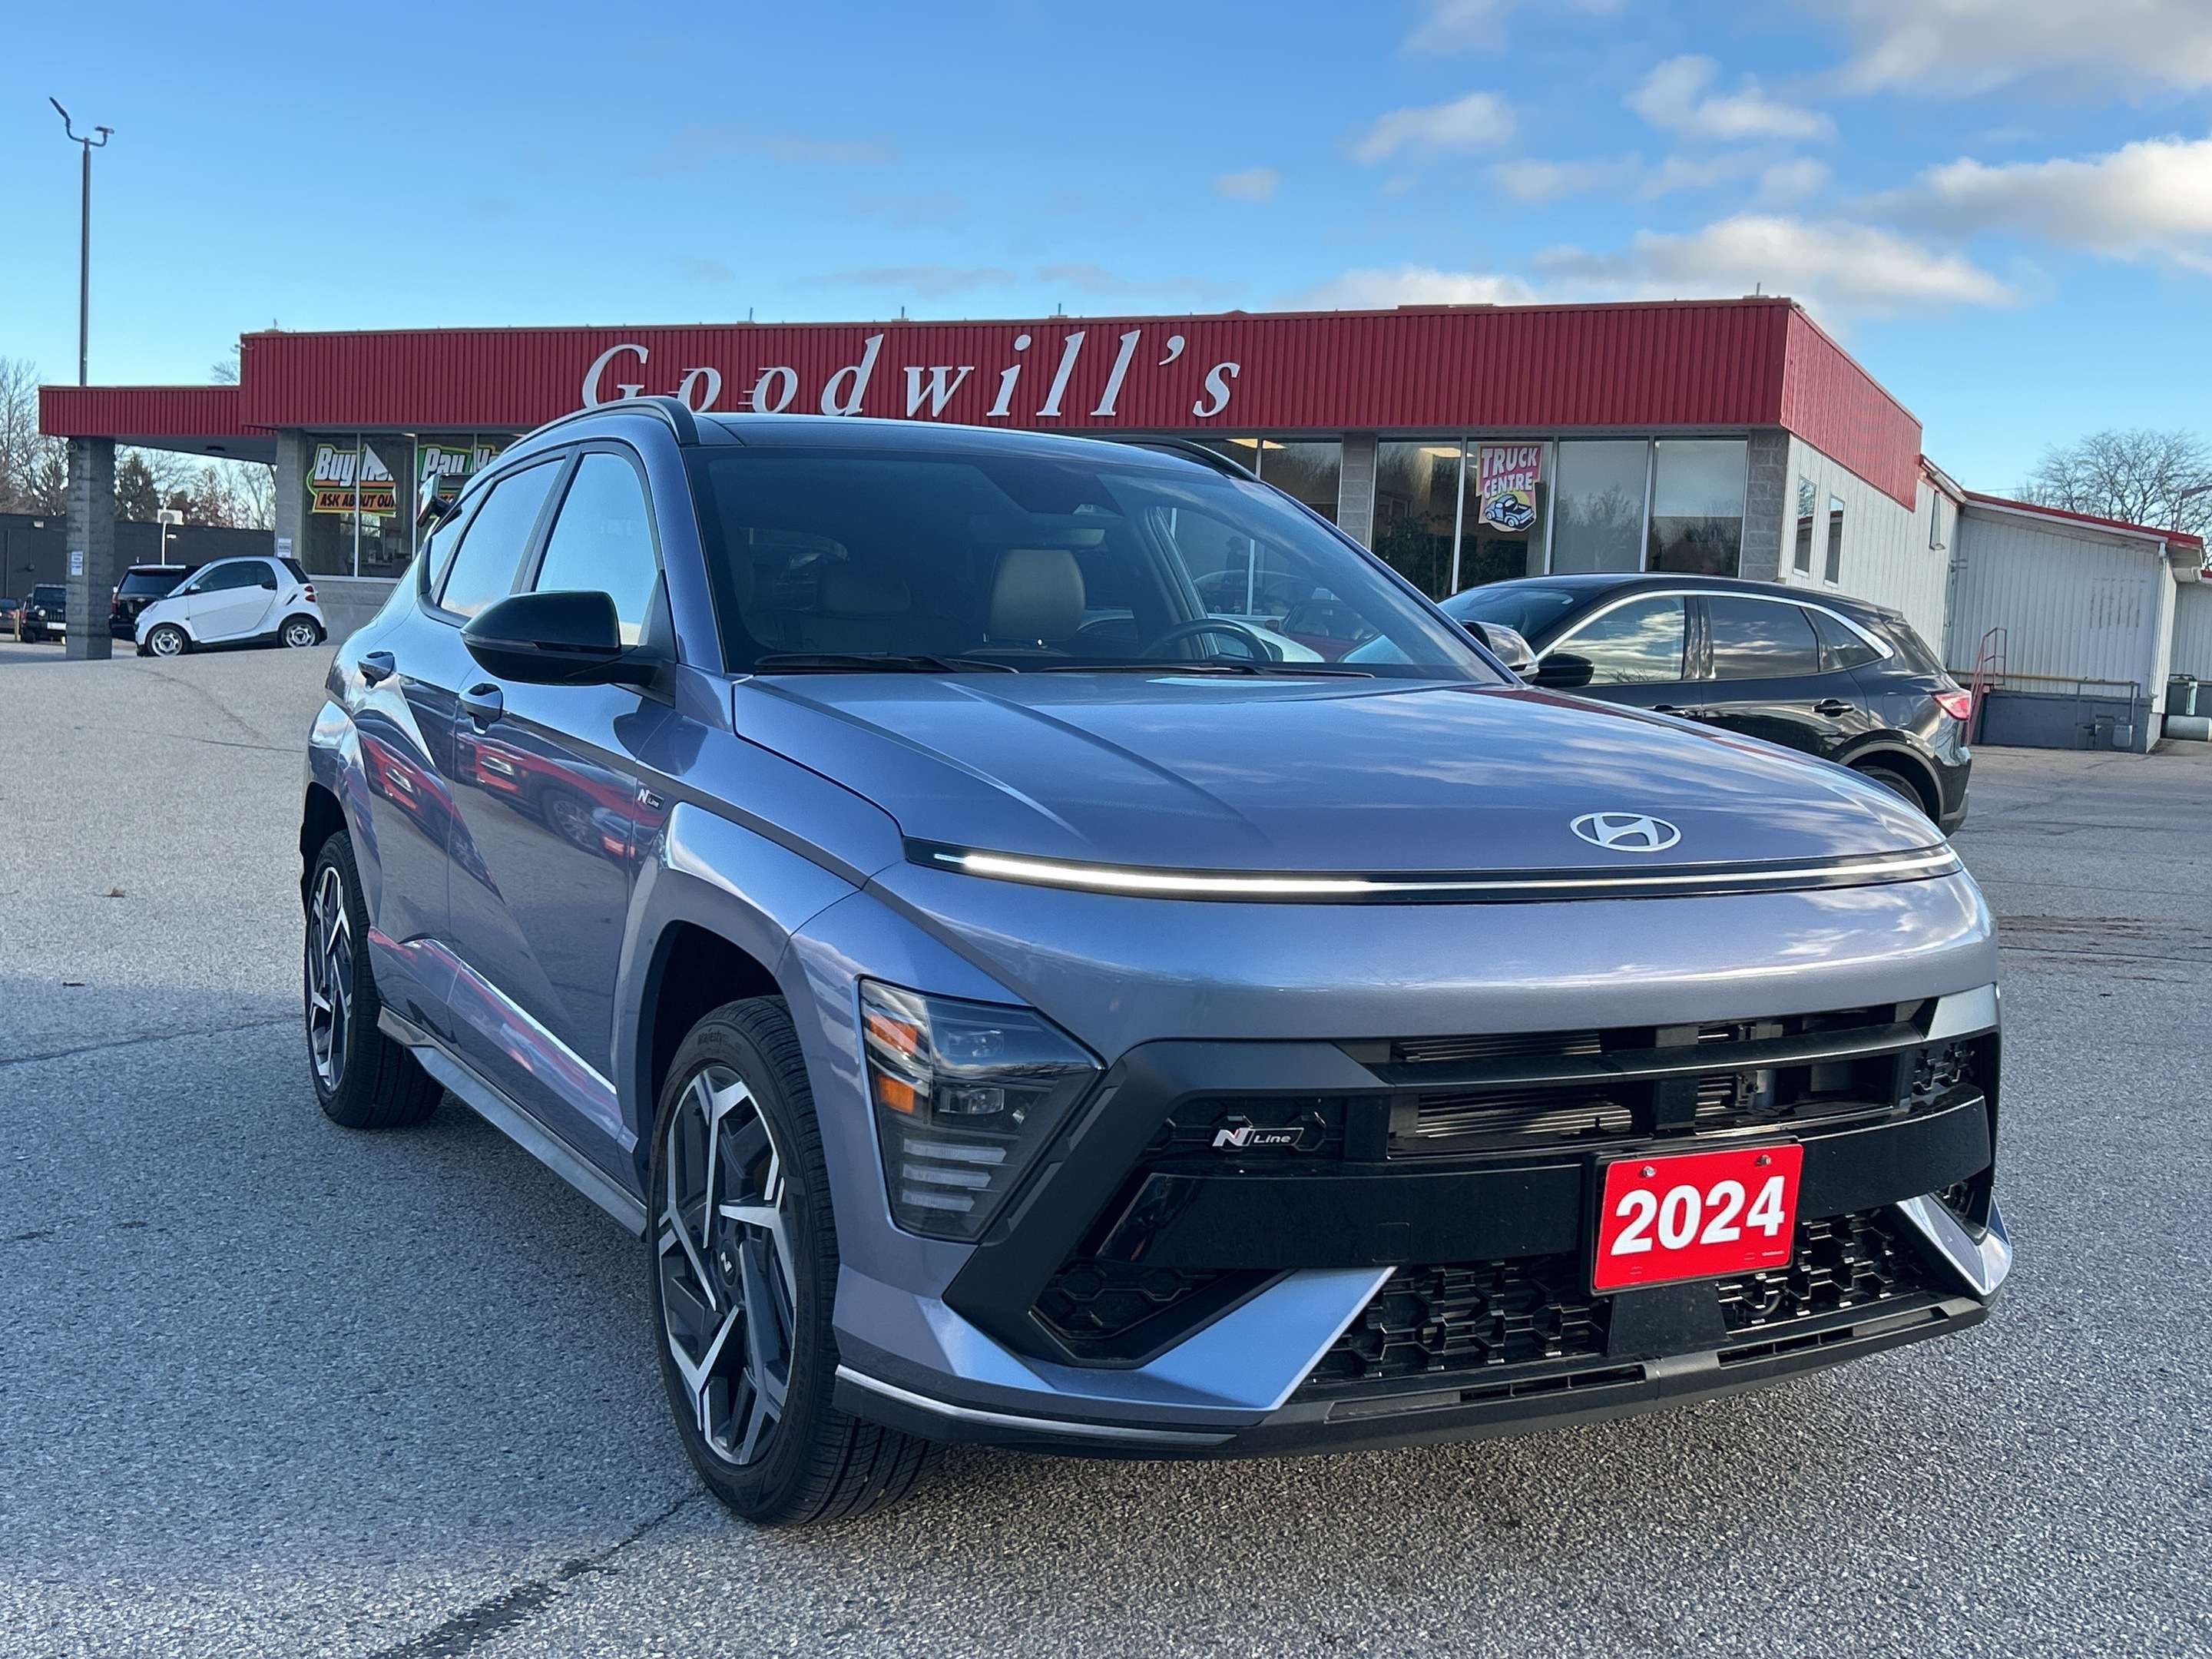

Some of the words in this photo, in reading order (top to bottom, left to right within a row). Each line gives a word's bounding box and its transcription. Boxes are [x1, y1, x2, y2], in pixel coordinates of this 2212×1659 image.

[582, 329, 1240, 416] Goodwill's
[313, 447, 356, 487] Buy
[1482, 448, 1538, 478] TRUCK
[320, 493, 339, 507] ASK
[1484, 472, 1533, 499] CENTRE
[1212, 1127, 1250, 1147] N
[1253, 1134, 1291, 1144] Line
[1611, 1175, 1785, 1256] 2024
